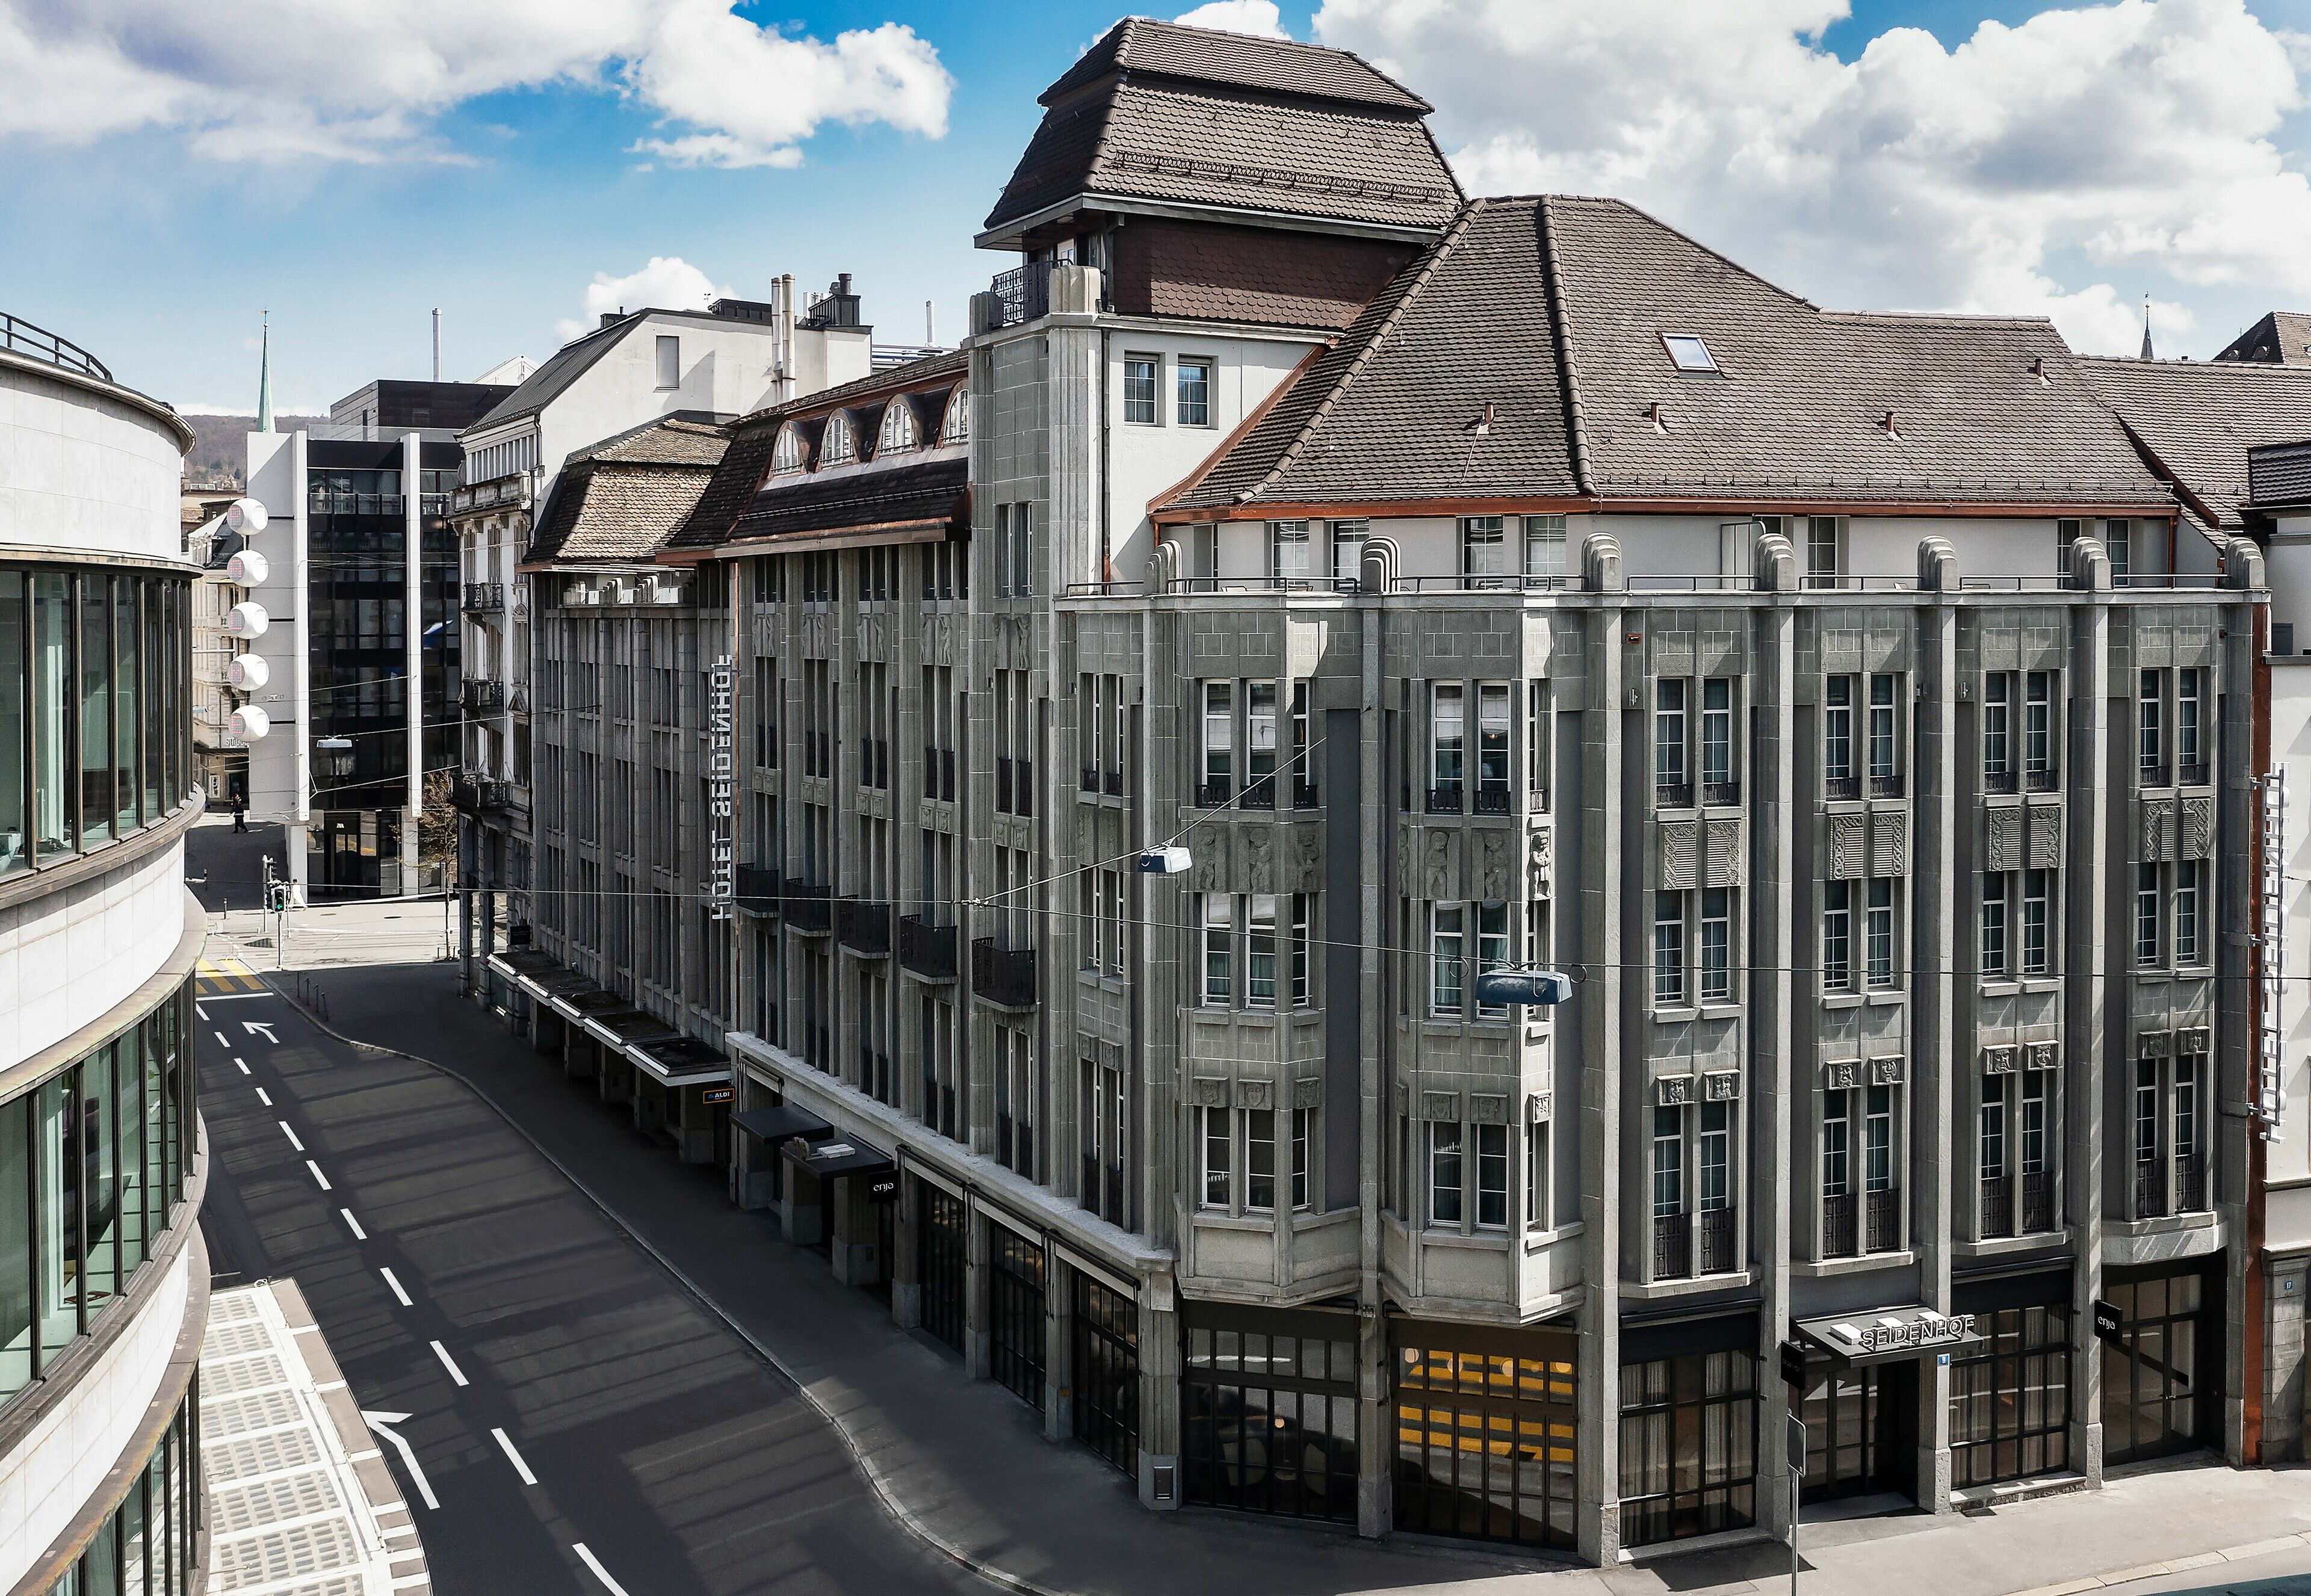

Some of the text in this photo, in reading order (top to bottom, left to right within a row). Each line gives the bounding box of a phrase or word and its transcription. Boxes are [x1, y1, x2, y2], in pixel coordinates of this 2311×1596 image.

[873, 1183, 894, 1192] enja
[2097, 1316, 2115, 1329] enja
[1861, 1314, 1975, 1348] SEIDENHOF
